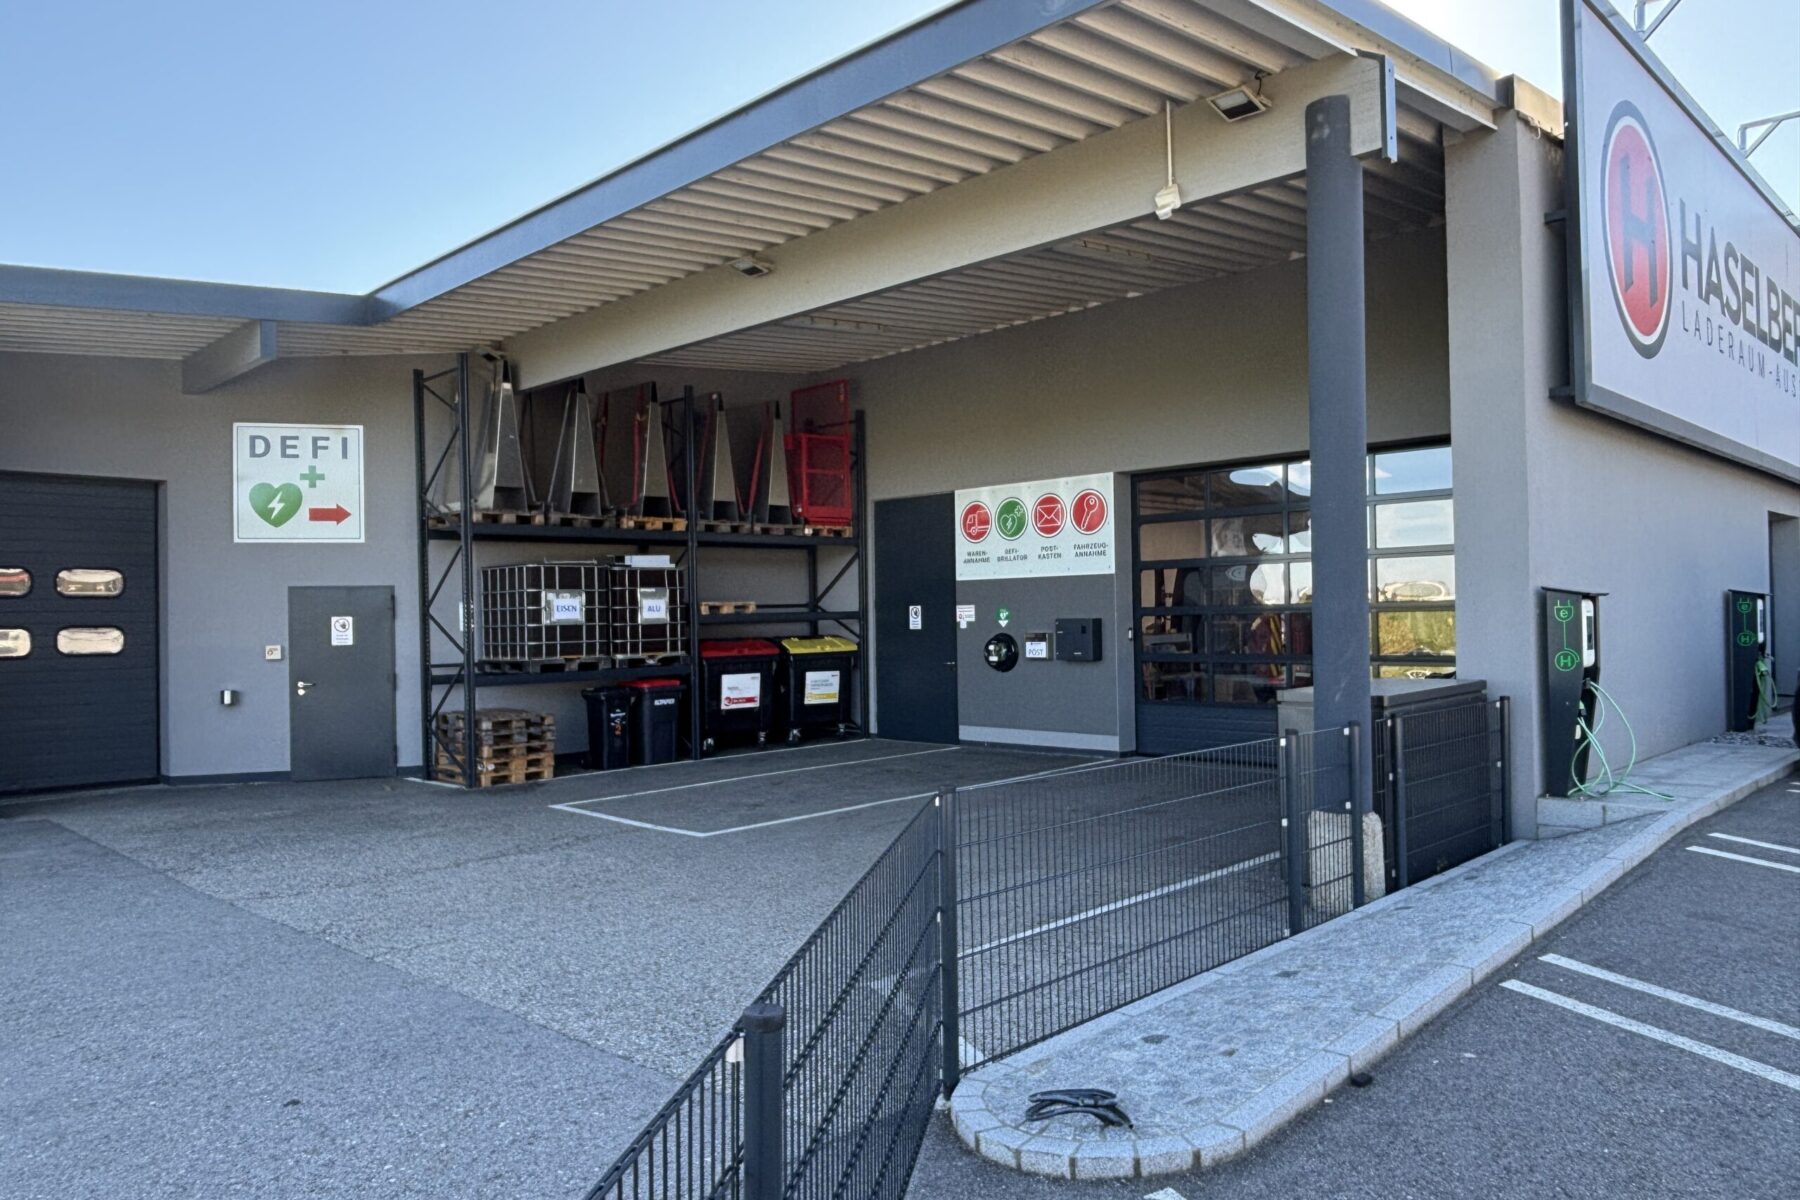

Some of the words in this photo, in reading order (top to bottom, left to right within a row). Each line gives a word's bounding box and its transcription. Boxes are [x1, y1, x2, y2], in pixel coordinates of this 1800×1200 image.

[248, 435, 349, 460] DEFI
[1073, 542, 1109, 551] FAHRZEUG-
[1038, 552, 1062, 560] KASTEN
[1075, 550, 1107, 558] ANNAHME
[556, 605, 577, 613] EISEN
[647, 605, 661, 613] ALU
